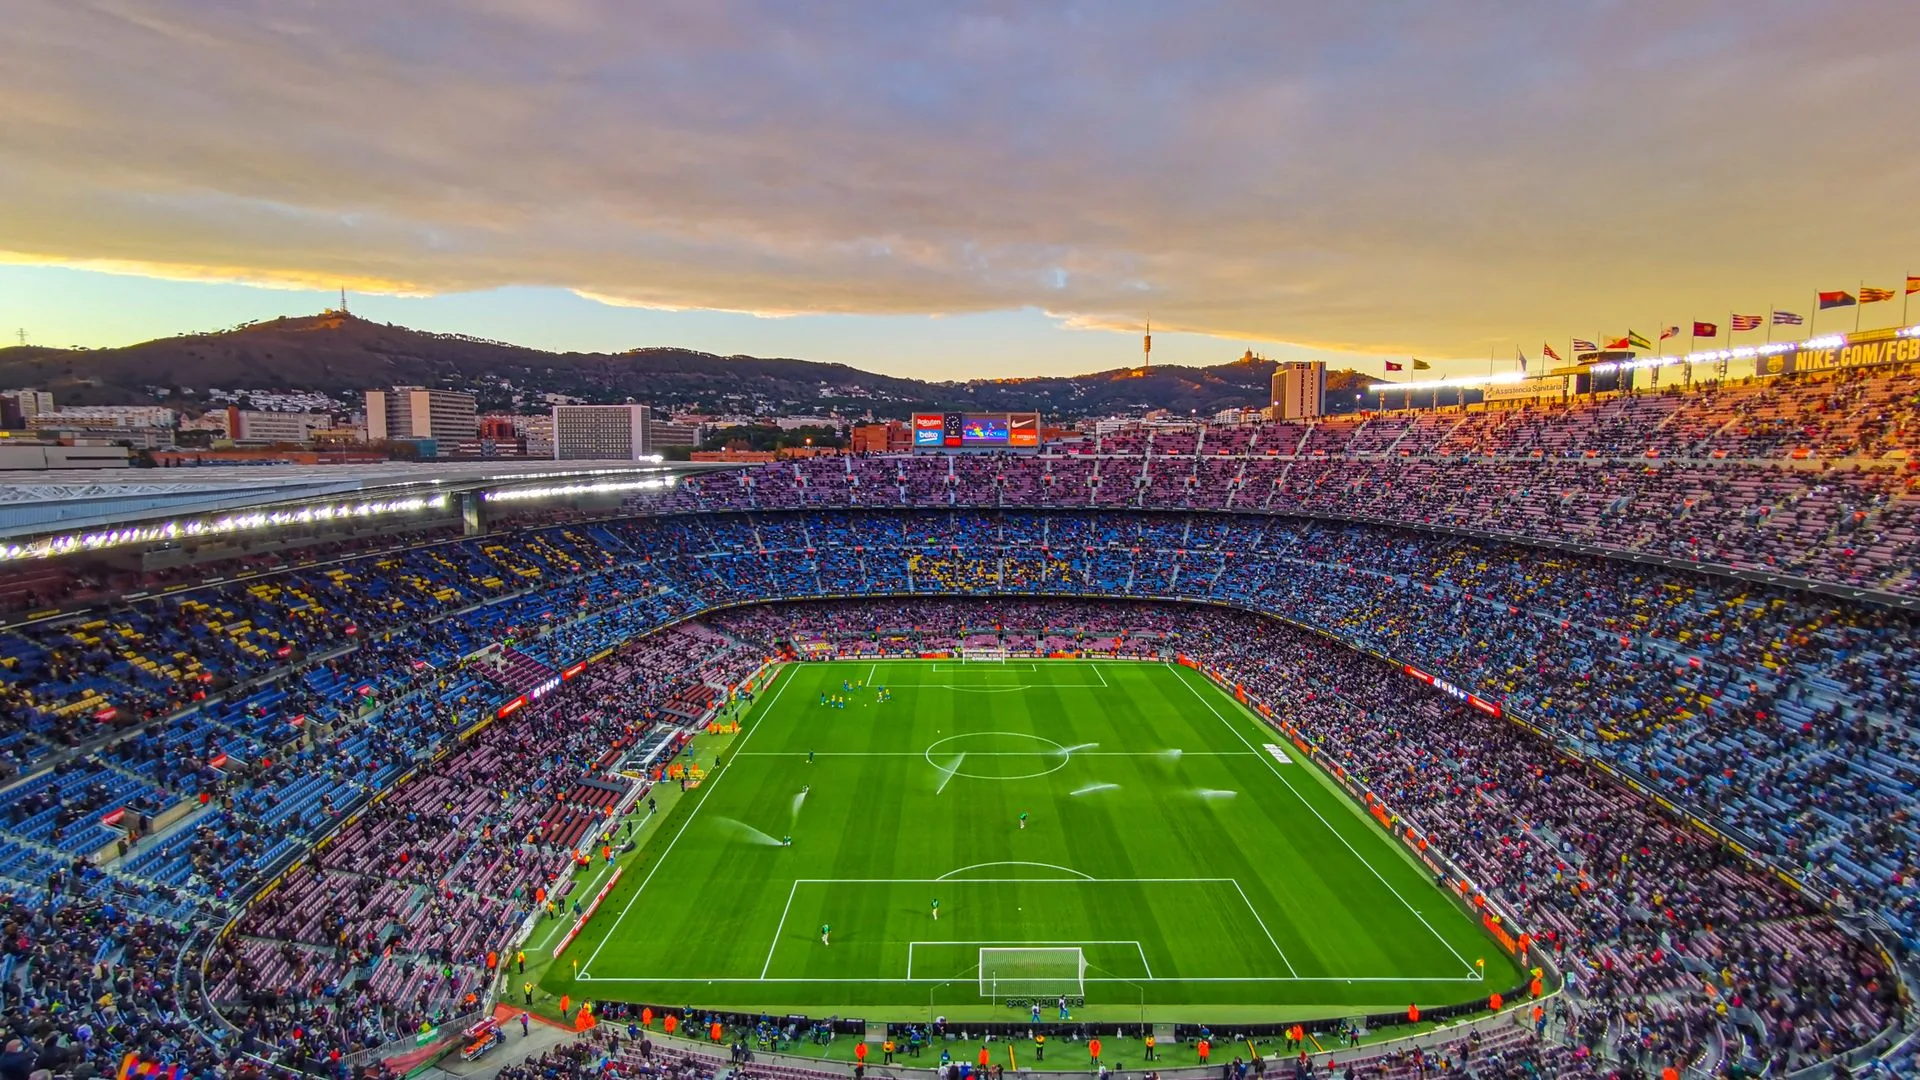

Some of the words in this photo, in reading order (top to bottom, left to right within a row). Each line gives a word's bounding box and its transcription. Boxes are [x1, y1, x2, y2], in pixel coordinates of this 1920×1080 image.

[1795, 338, 1920, 371] NIKE.COM/FCB
[917, 418, 941, 427] Rakuten
[919, 431, 938, 440] beko
